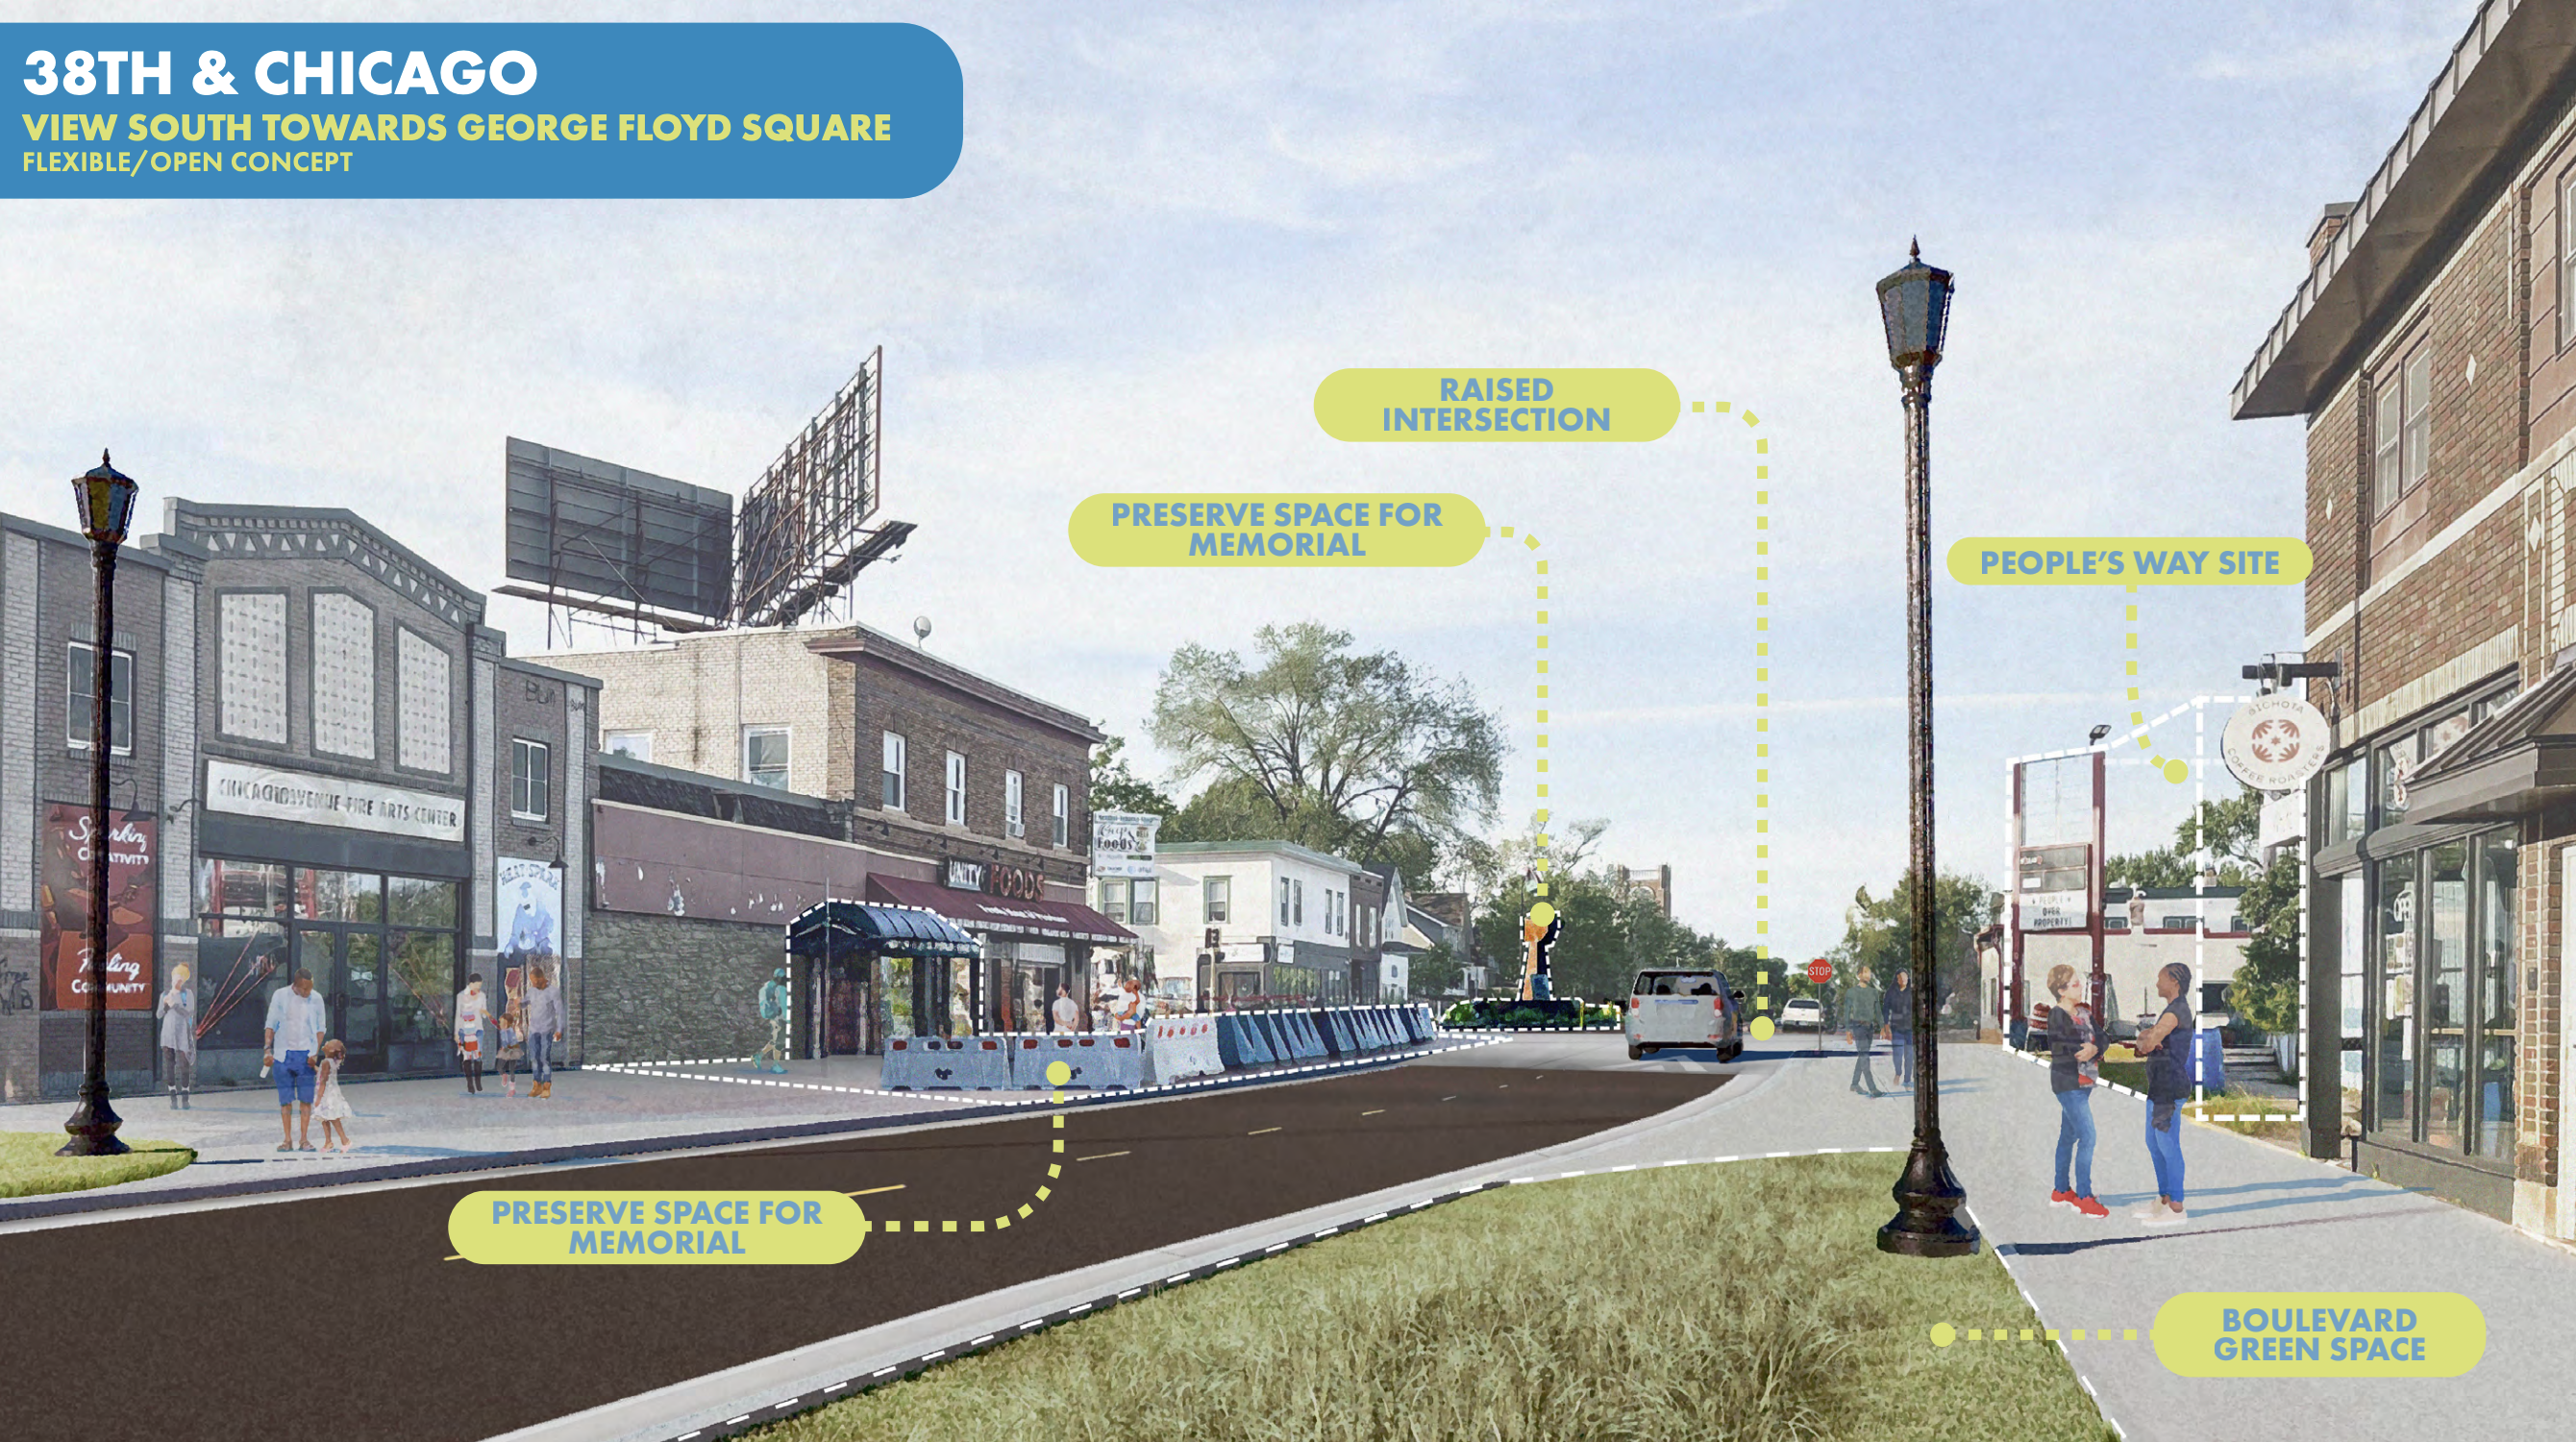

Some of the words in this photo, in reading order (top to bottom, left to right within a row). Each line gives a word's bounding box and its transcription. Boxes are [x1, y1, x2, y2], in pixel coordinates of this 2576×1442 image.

[2249, 700, 2304, 716] BICHOTA
[2227, 747, 2266, 783] COFFEE
[2269, 744, 2325, 784] ROASTERS
[379, 802, 409, 821] ARTS
[414, 807, 457, 827] CENTER
[949, 857, 982, 884] UNITY
[990, 862, 1045, 903] FOODS
[1808, 966, 1831, 976] STOP
